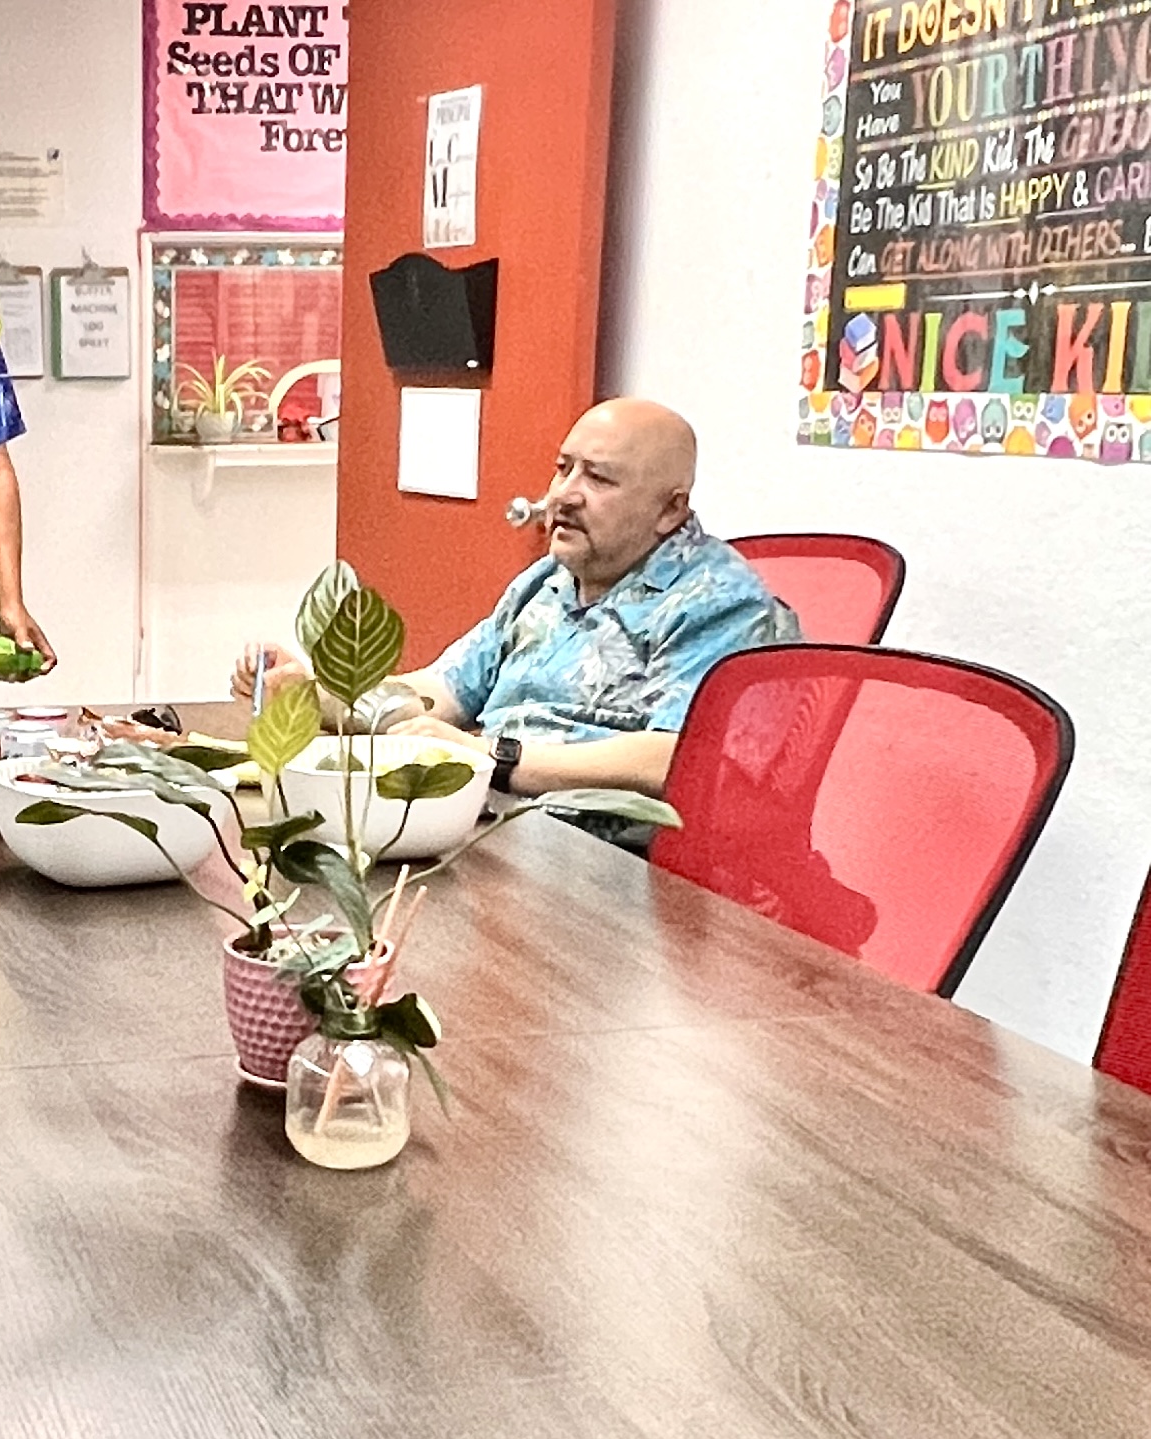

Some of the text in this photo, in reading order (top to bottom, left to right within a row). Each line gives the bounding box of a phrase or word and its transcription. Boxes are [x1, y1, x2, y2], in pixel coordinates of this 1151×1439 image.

[182, 3, 328, 37] PLANT
[862, 8, 891, 62] IT
[167, 41, 341, 77] Seeds OF
[186, 82, 302, 114] THAT
[870, 79, 902, 105] You
[912, 53, 1009, 129] YOUR
[260, 120, 347, 152] Fore
[856, 112, 899, 141] Have
[852, 156, 873, 193] So
[875, 152, 897, 188] Be
[900, 145, 926, 184] The
[929, 138, 980, 180] KIND
[1024, 123, 1056, 166] The
[850, 200, 873, 234] Be
[875, 197, 905, 231] The
[906, 193, 933, 227] Kid
[938, 187, 977, 224] That
[979, 186, 996, 219] Is
[1000, 172, 1070, 217] HAPPY
[1072, 170, 1089, 208] &
[847, 245, 876, 278] Can
[881, 238, 915, 274] GET
[917, 232, 981, 274] ALONG
[985, 228, 1032, 268] WITH
[878, 308, 1029, 395] NICE
